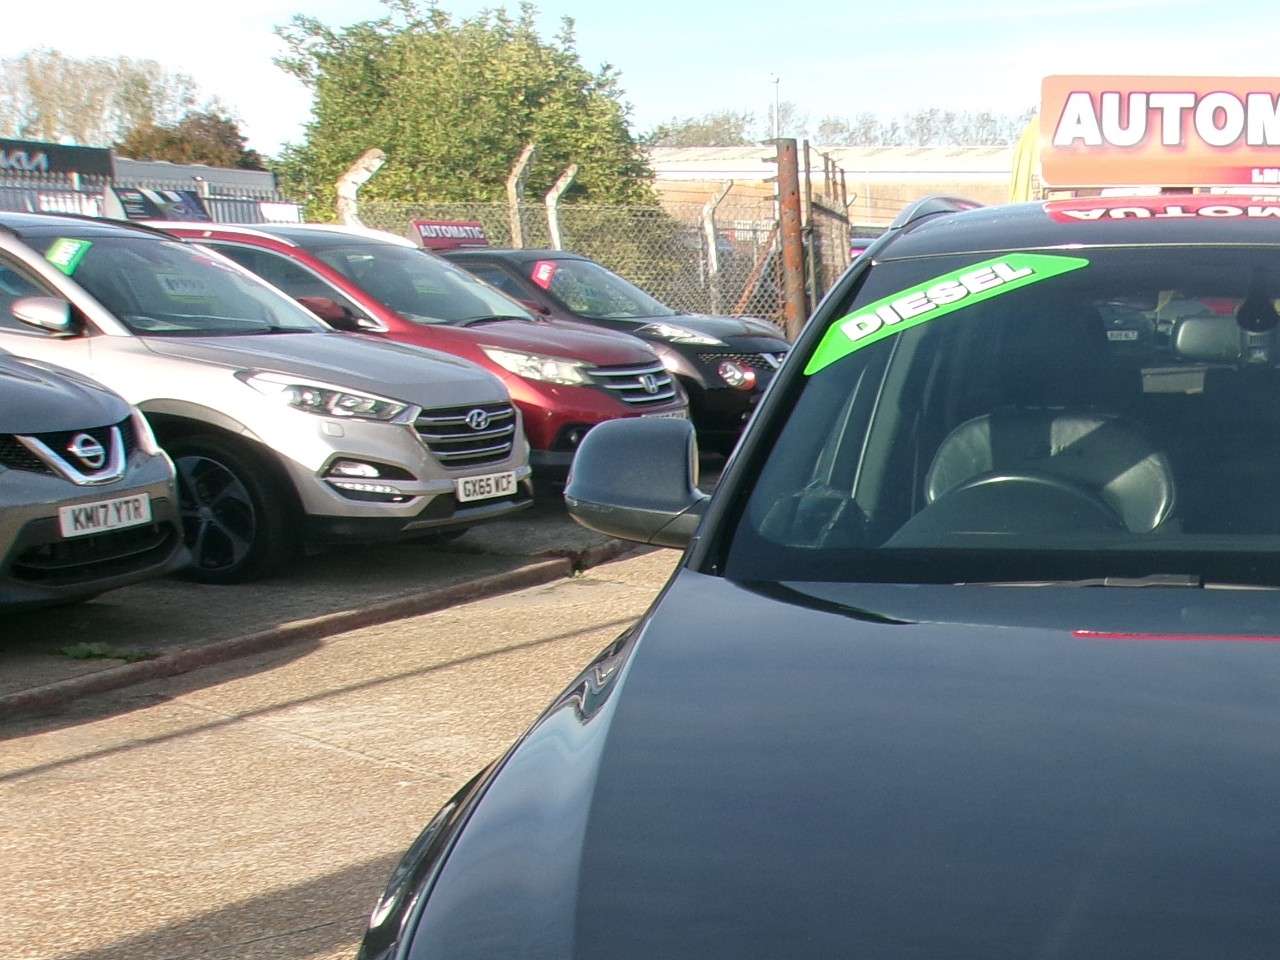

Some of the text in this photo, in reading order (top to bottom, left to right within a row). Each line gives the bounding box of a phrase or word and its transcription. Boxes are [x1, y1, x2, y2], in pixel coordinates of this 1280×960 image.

[419, 225, 485, 239] AUTOMATIC
[840, 260, 1034, 342] DIESEL
[463, 477, 493, 498] GX65
[72, 498, 143, 531] KM17 YTR
